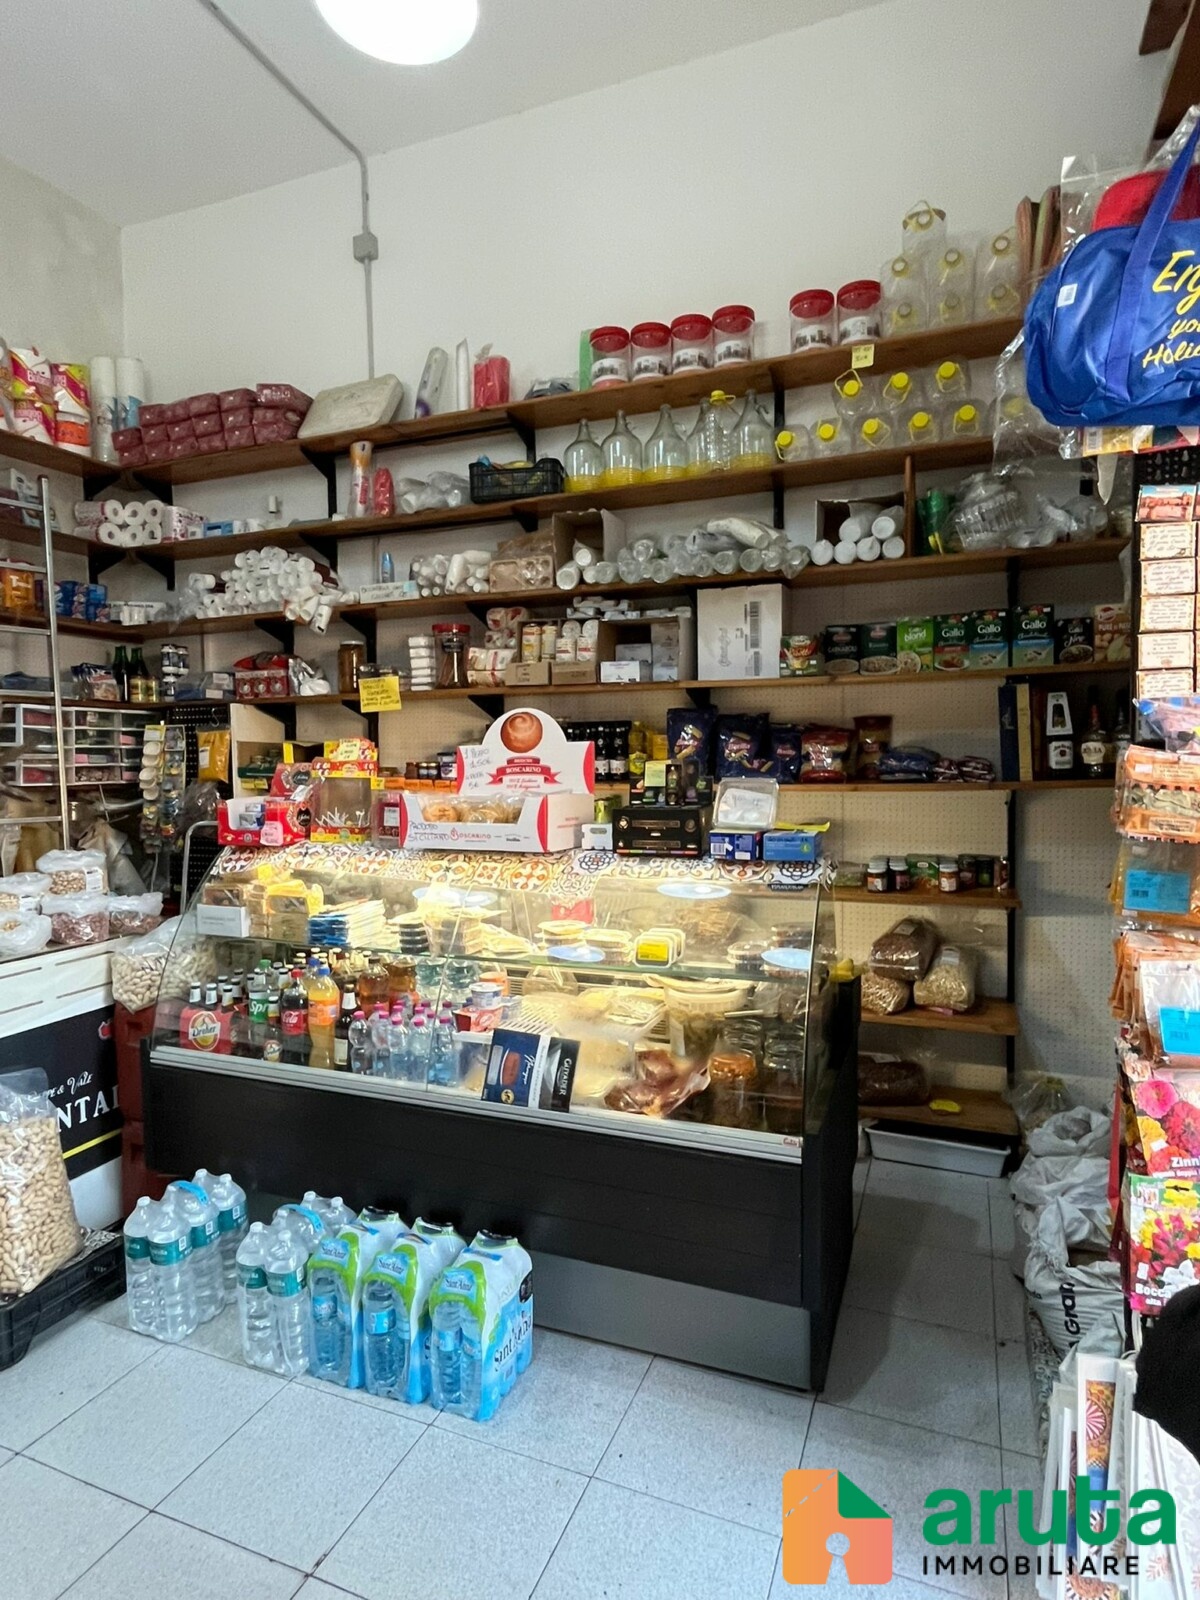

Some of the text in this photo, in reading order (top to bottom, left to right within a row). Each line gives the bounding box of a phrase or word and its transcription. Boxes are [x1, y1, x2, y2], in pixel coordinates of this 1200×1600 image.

[1167, 318, 1200, 339] yo
[977, 625, 1001, 634] Gallo
[1022, 620, 1046, 630] Gallo
[941, 628, 964, 638] Gallo
[506, 766, 542, 774] BOSCARINO
[1171, 1156, 1200, 1168] Zinn
